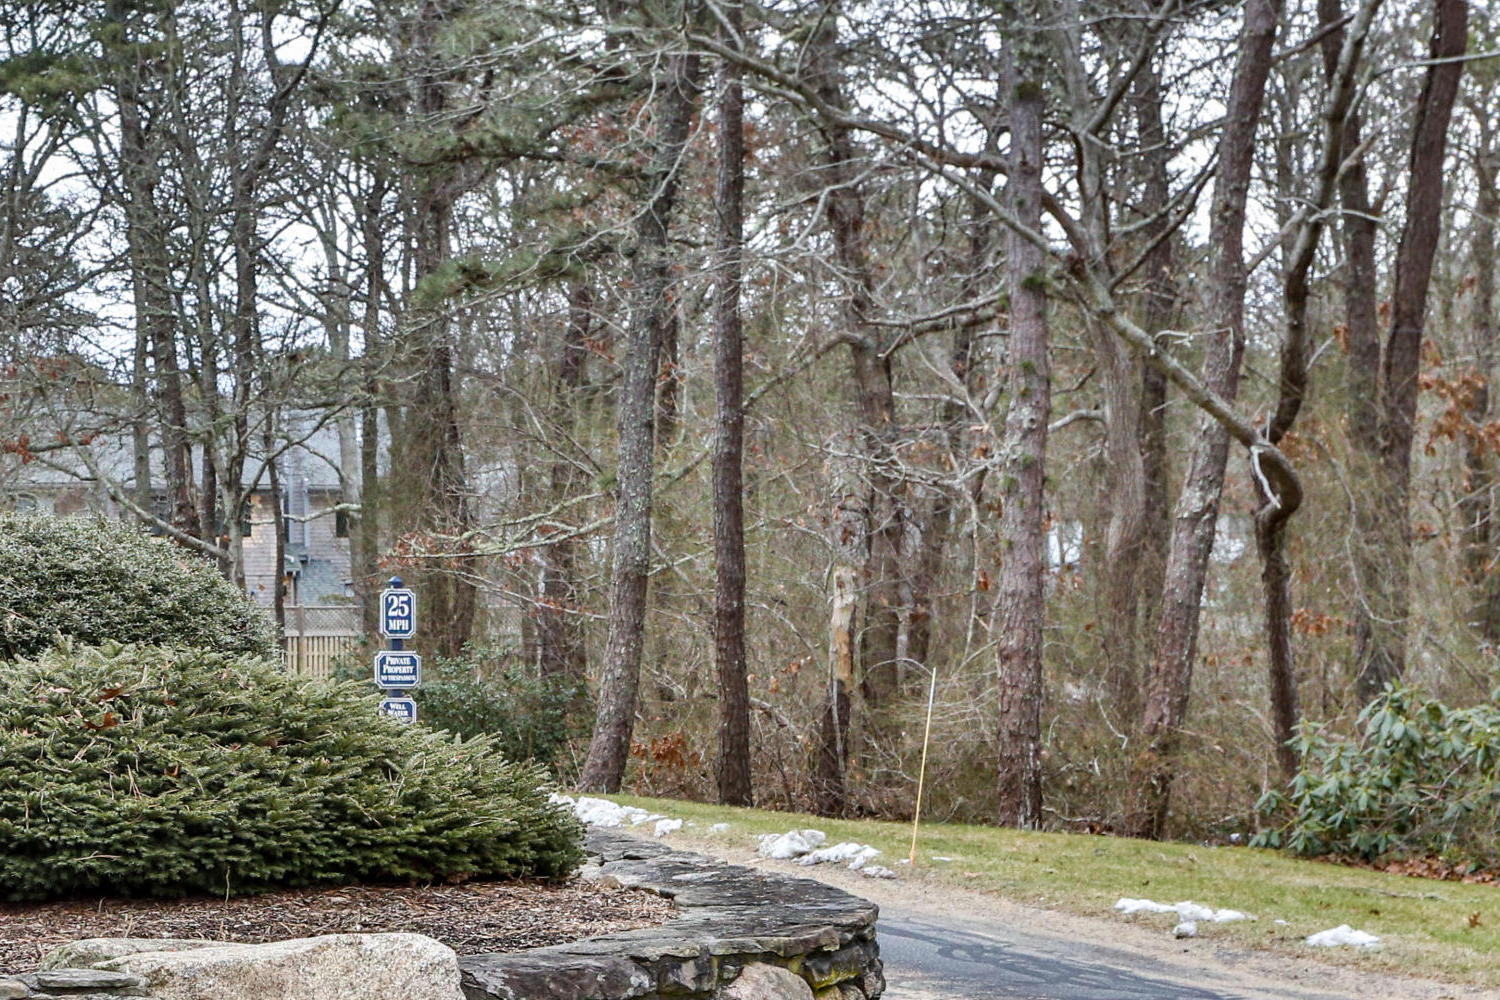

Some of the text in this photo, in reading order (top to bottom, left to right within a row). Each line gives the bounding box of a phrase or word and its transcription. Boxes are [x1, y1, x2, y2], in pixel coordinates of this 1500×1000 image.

[388, 595, 409, 617] 25
[388, 619, 409, 630] MPH
[386, 656, 411, 665] PRIVATE
[383, 665, 414, 674] PROPERTY
